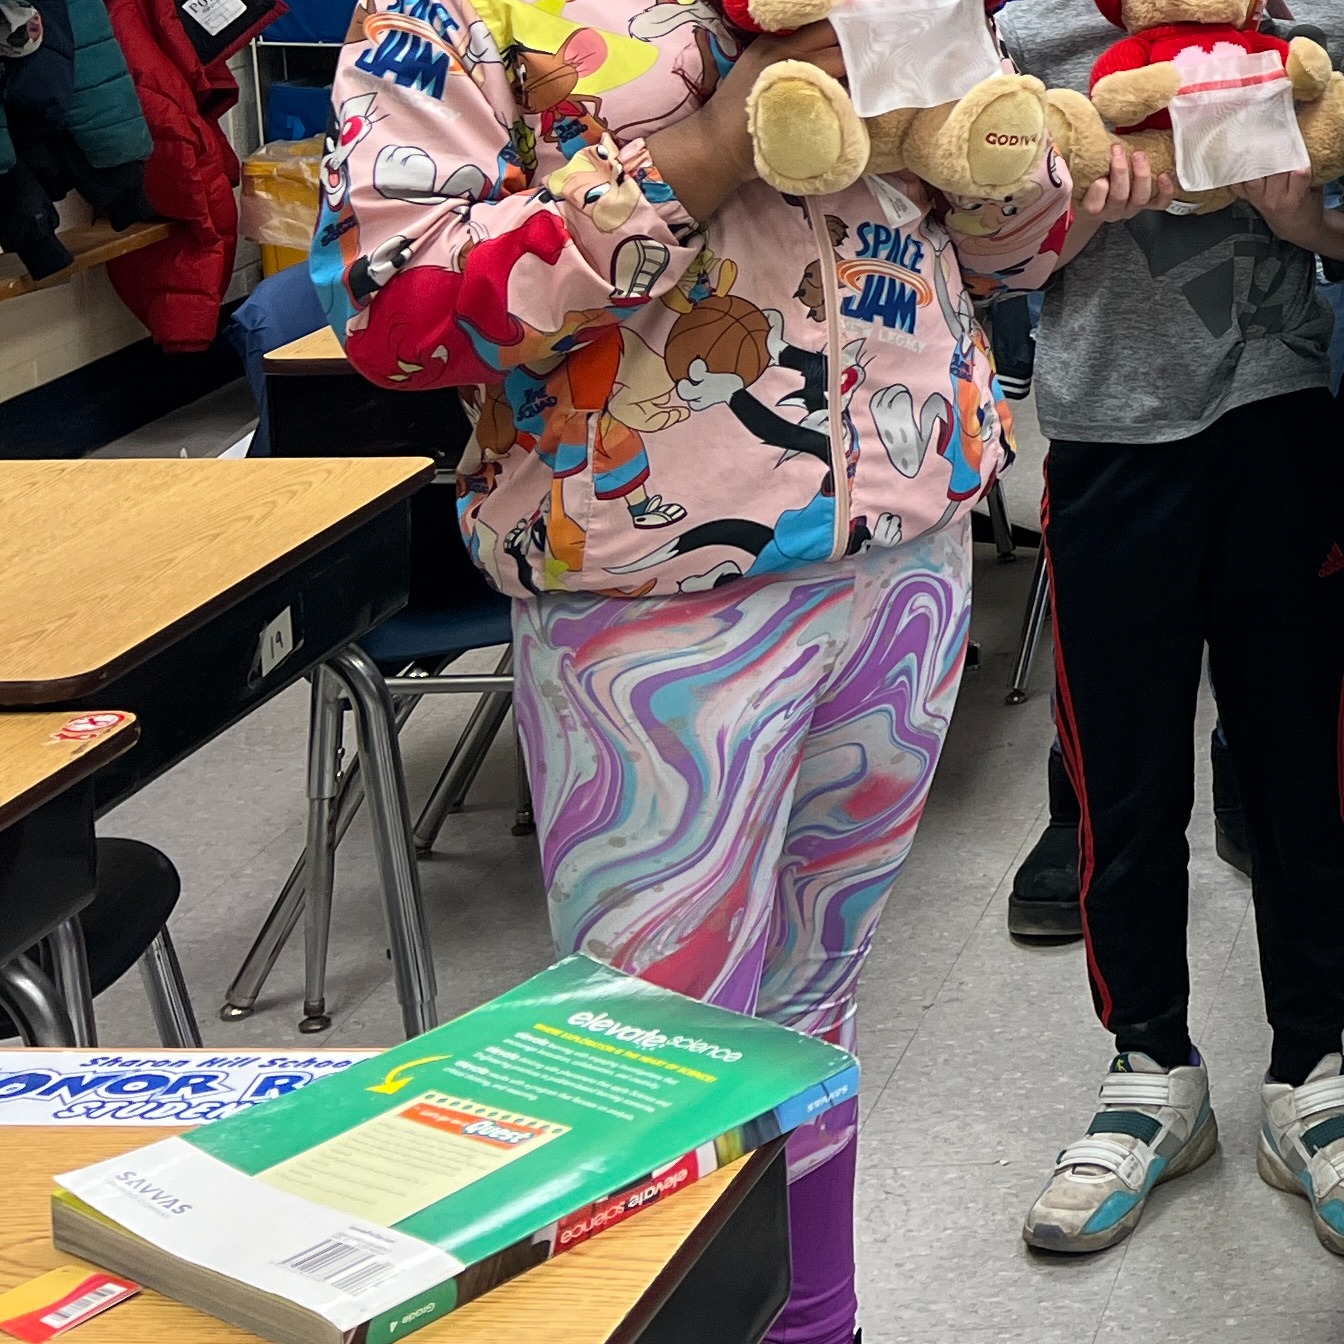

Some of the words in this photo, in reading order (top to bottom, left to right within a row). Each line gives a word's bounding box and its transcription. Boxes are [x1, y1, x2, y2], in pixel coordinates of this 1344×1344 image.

[355, 28, 450, 100] JAM
[855, 222, 924, 274] SPACE
[841, 274, 918, 334] JAM
[80, 1056, 189, 1068] Sharon
[197, 1056, 254, 1068] Hill
[259, 1056, 353, 1069] Schoo
[666, 1035, 743, 1063] science
[464, 1120, 531, 1145] Quest
[115, 1170, 193, 1215] SAVVAS
[626, 1167, 689, 1209] elevate
[560, 1200, 626, 1246] science
[389, 1320, 400, 1334] 4
[402, 1301, 436, 1324] Grade
